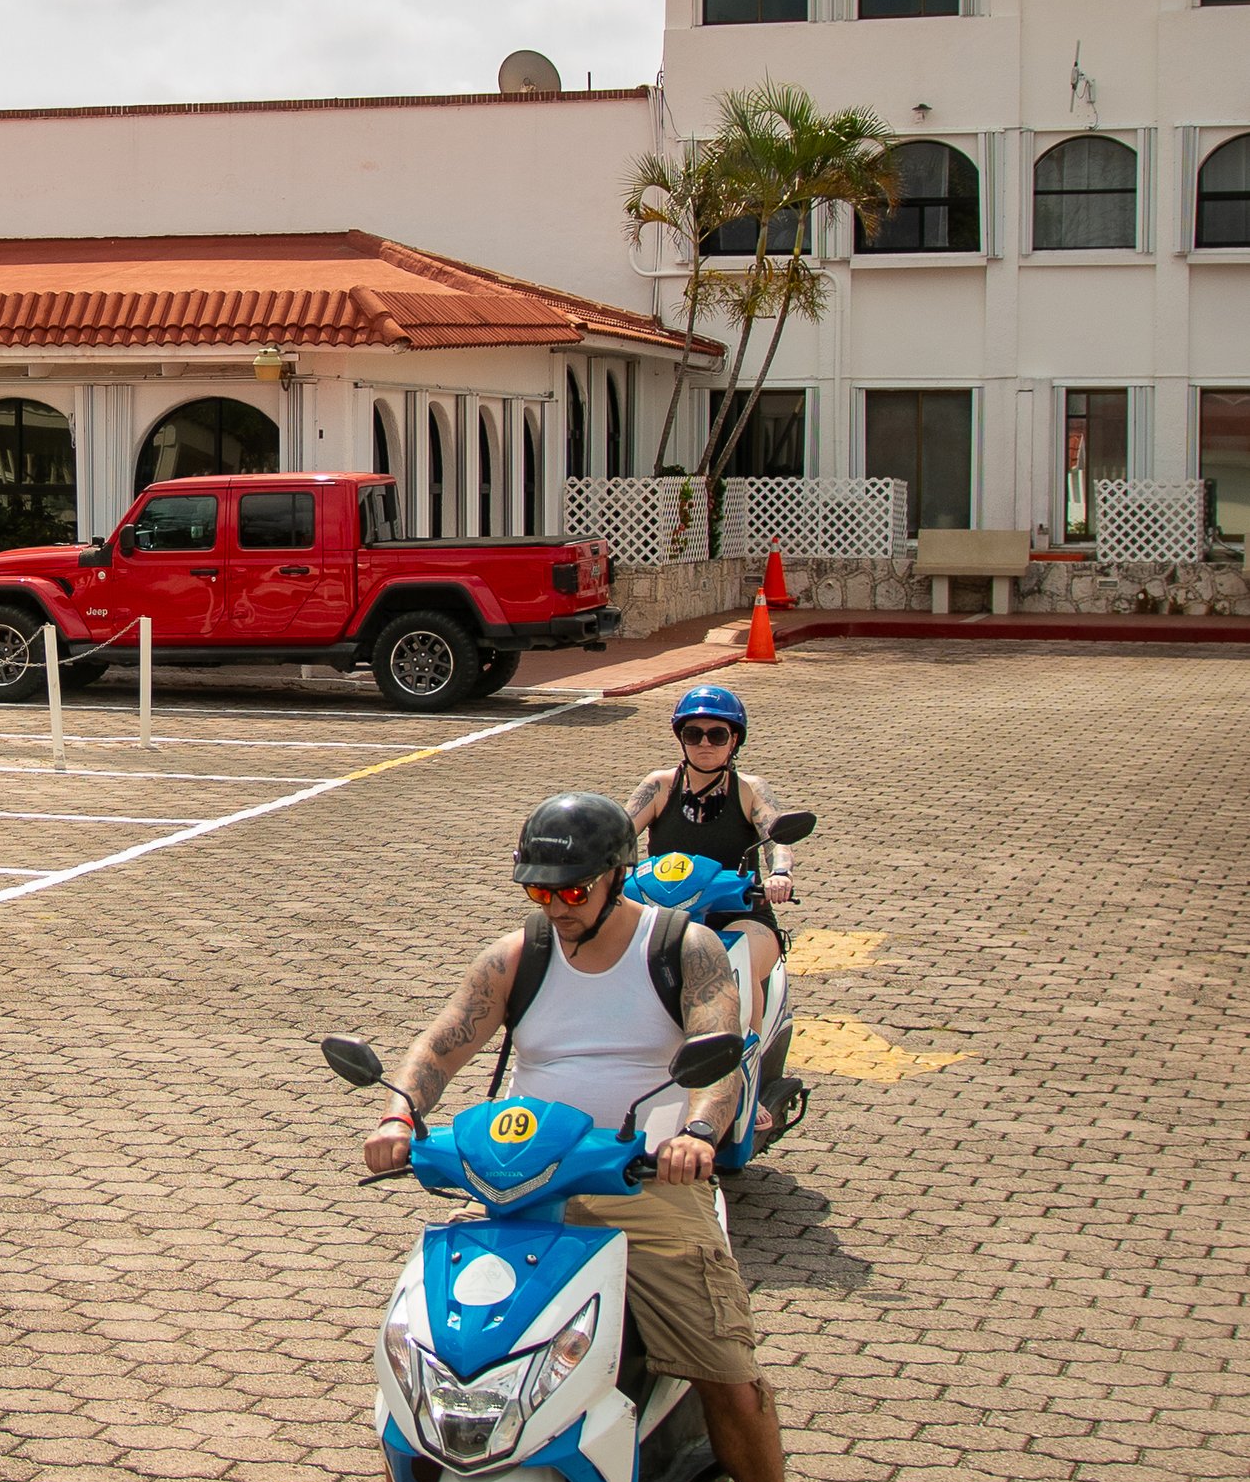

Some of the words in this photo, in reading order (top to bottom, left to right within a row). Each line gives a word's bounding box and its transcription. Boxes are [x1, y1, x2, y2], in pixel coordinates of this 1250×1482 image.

[86, 606, 109, 618] Jeep
[660, 860, 687, 874] 04
[498, 1113, 530, 1136] 09
